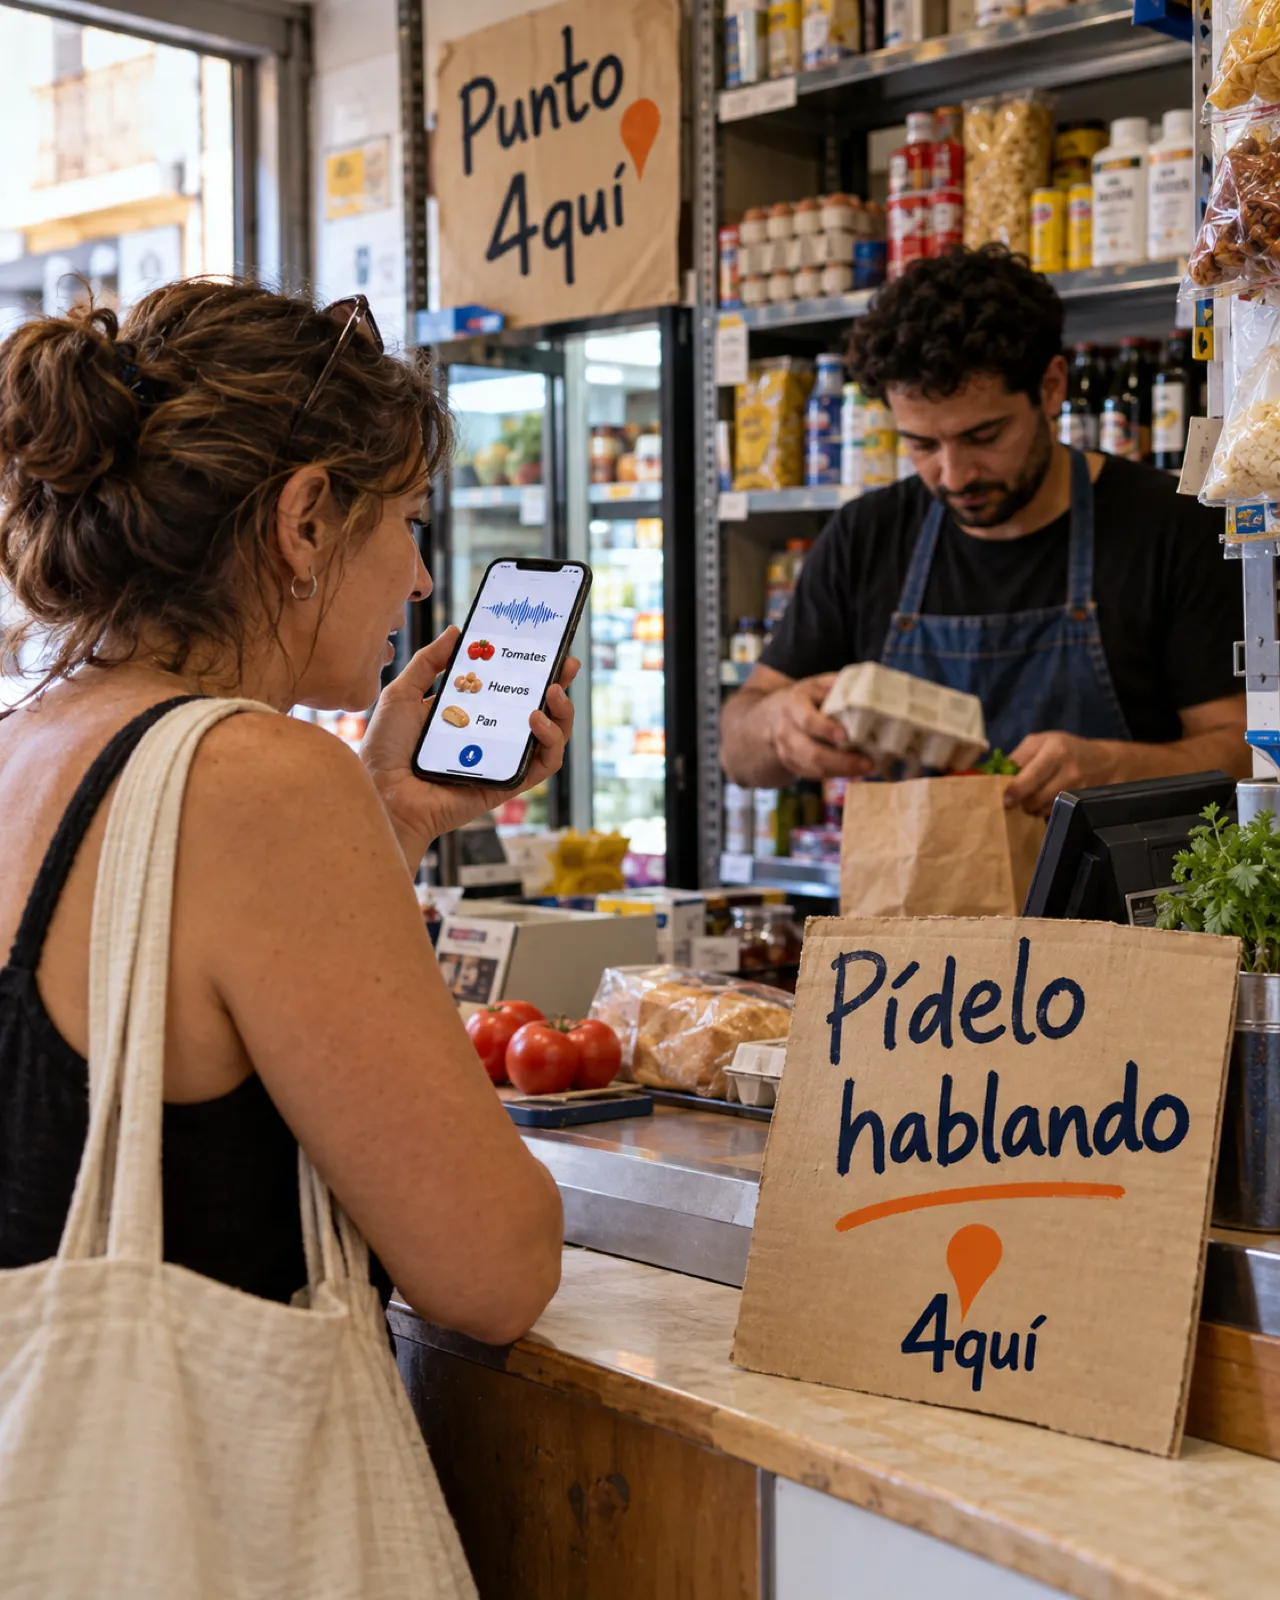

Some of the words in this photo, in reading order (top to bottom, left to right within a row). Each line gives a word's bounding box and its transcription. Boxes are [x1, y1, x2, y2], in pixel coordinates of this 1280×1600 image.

[458, 24, 624, 177] Punto
[487, 680, 530, 696] Huevos
[500, 647, 547, 663] Tomates
[475, 714, 498, 728] Pan
[826, 936, 1086, 1066] Pídelo
[835, 1059, 1190, 1178] hablando
